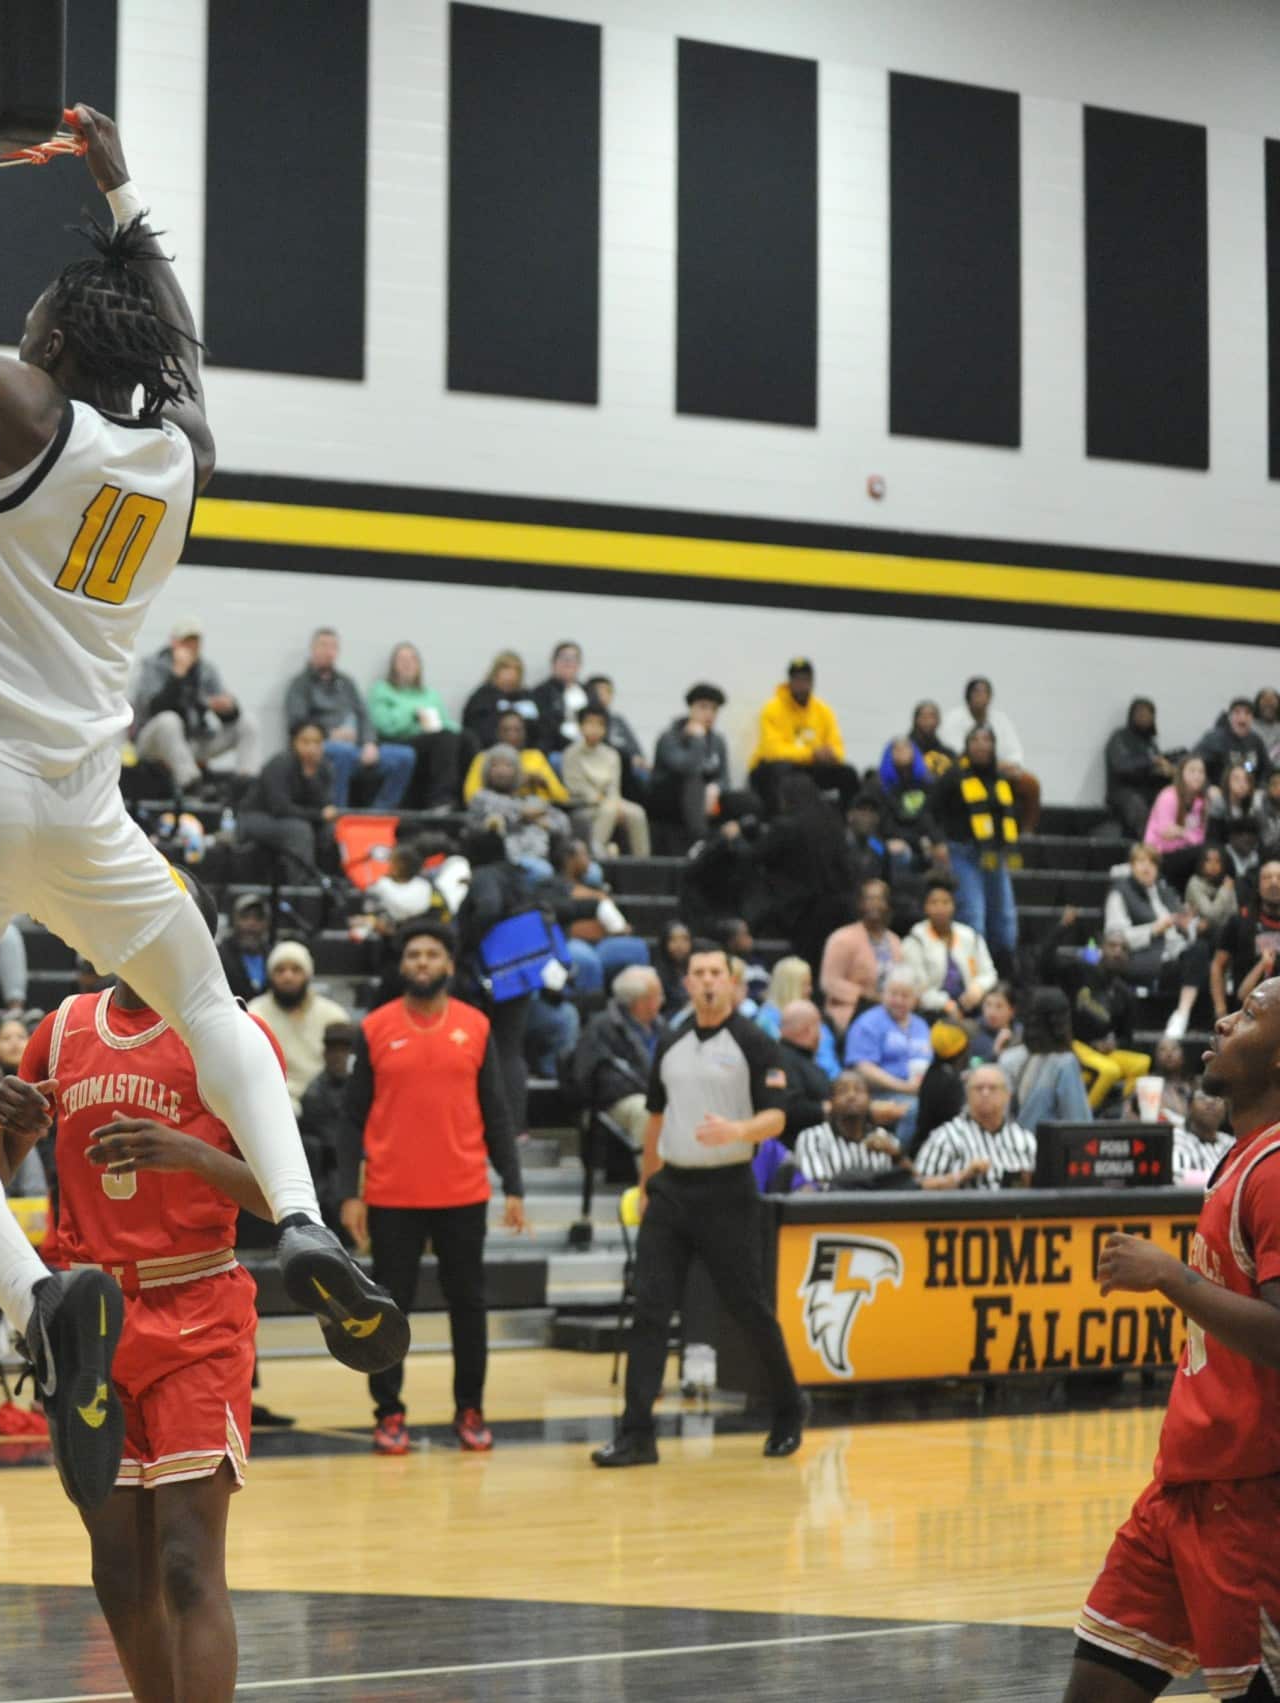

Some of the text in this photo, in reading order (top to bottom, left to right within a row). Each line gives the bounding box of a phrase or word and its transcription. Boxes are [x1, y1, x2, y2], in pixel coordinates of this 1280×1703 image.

[54, 483, 167, 606] 10
[61, 1073, 182, 1124] THOMASVILLE
[924, 1224, 1072, 1289] HOME
